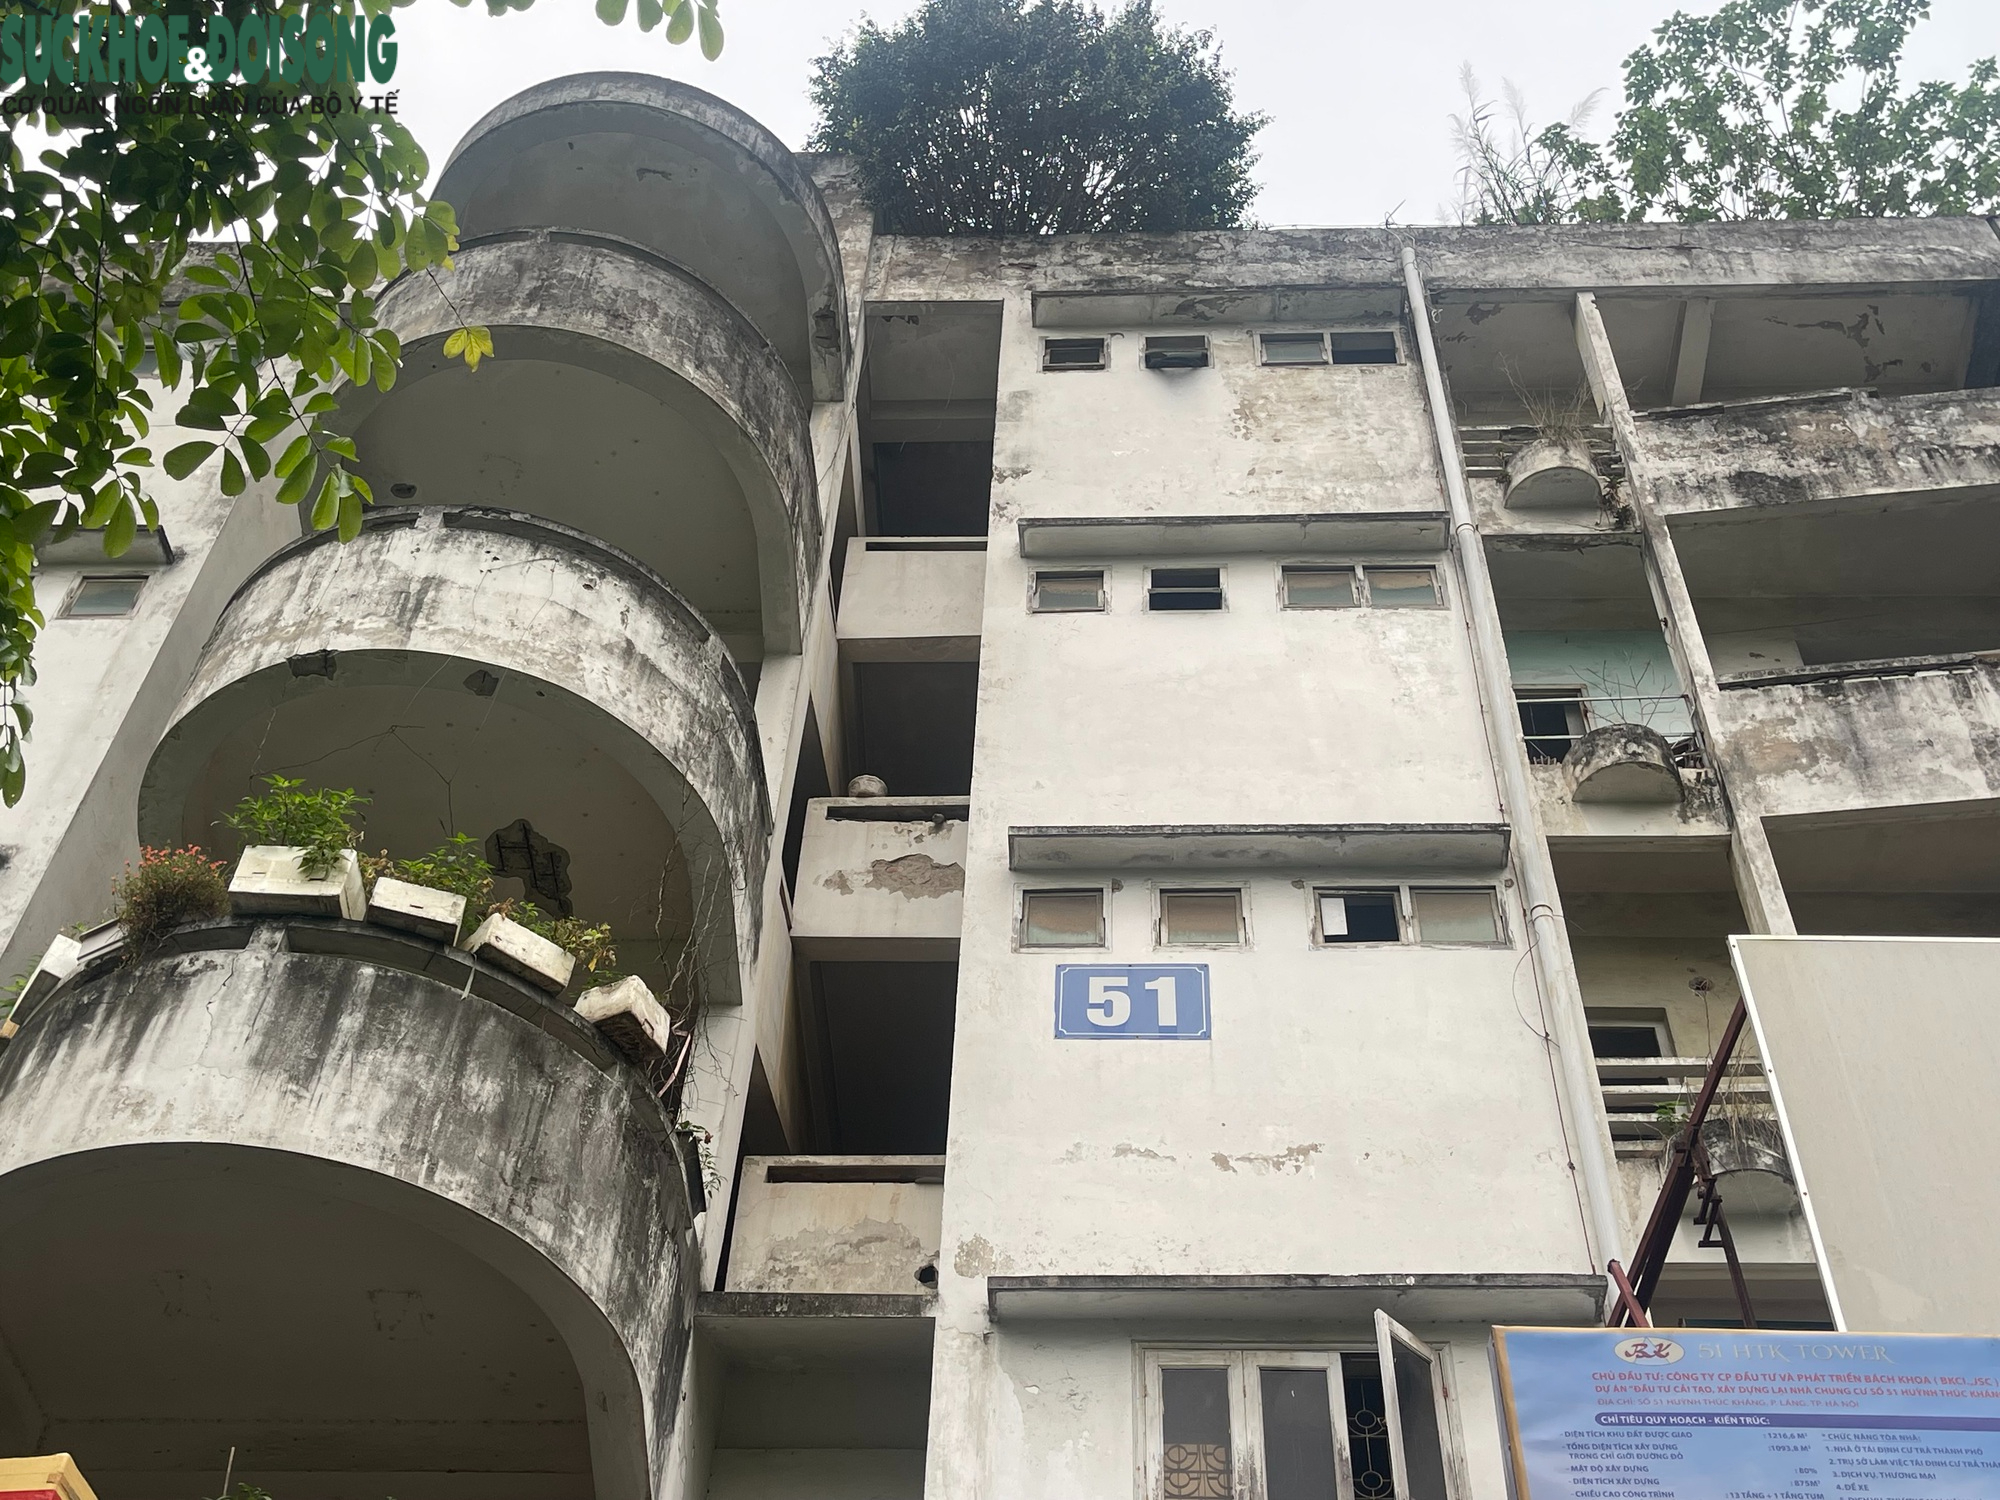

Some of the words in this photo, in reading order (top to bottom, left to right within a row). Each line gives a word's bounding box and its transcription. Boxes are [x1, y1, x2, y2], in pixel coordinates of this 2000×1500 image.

[1086, 976, 1178, 1027] 51
[1698, 1344, 1722, 1359] 51
[1734, 1344, 1791, 1363] HTK
[1794, 1344, 1896, 1364] TOWER
[1592, 1370, 1615, 1381] CHỦ
[1618, 1370, 1642, 1381] ĐẦU
[1645, 1372, 1664, 1381] TƯ:
[1666, 1371, 1699, 1381] CÔNG
[1700, 1373, 1715, 1381] TY
[1717, 1373, 1732, 1381] CP
[1735, 1371, 1759, 1382] ĐẦU
[1760, 1373, 1777, 1382] TƯ
[1779, 1372, 1795, 1382] VÀ
[1797, 1372, 1826, 1383] PHÁT
[1828, 1372, 1862, 1383] TRIỂN
[1864, 1373, 1895, 1384] BÁCH
[1897, 1375, 1931, 1384] KHOA
[1595, 1384, 1611, 1394] DỰ
[1613, 1384, 1627, 1393] ÁN
[1657, 1385, 1671, 1393] TƯ
[1673, 1384, 1690, 1393] CẢI
[1717, 1385, 1736, 1394] XÂY
[1738, 1385, 1769, 1396] DỰNG
[1771, 1387, 1788, 1395] LẠI
[1789, 1385, 1812, 1394] NHÀ
[1814, 1387, 1852, 1395] CHUNG
[1853, 1387, 1868, 1395] CƯ
[1870, 1385, 1884, 1395] SỐ
[1901, 1387, 1938, 1397] HUỲNH
[1939, 1388, 1968, 1397] THÚC
[1969, 1389, 2000, 1398] KHÁN
[1600, 1413, 1618, 1424] CHỈ
[1620, 1414, 1643, 1424] TIÊU
[1645, 1416, 1667, 1425] QUY
[1669, 1416, 1706, 1426] HOẠCH
[1714, 1414, 1737, 1424] KIẾN
[1739, 1415, 1770, 1425] TRÚC:
[1564, 1430, 1585, 1439] DIỆN
[1586, 1429, 1605, 1438] TÍCH
[1626, 1428, 1643, 1438] ĐẤT
[1644, 1430, 1670, 1439] ĐƯỢC
[1592, 1442, 1612, 1452] DIỆN
[1613, 1441, 1633, 1450] TÍCH
[1634, 1442, 1650, 1450] XÂY
[1652, 1443, 1678, 1452] DỰNG
[1901, 1446, 1913, 1454] CƯ
[1569, 1452, 1598, 1460] TRONG
[1600, 1451, 1615, 1460] CHỈ
[1636, 1451, 1669, 1460] ĐƯỜNG
[1570, 1464, 1588, 1474] MẬT
[1605, 1464, 1621, 1473] XÂY
[1623, 1465, 1649, 1474] DỰNG
[1573, 1477, 1593, 1486] DIỆN
[1594, 1477, 1615, 1485] TÍCH
[1615, 1477, 1632, 1485] XÂY
[1634, 1478, 1660, 1486] DỰNG
[1602, 1490, 1621, 1498] CAO
[1622, 1489, 1647, 1498] CÔNG
[1648, 1489, 1675, 1498] TRÌNH
[1804, 1492, 1825, 1500] TUM
